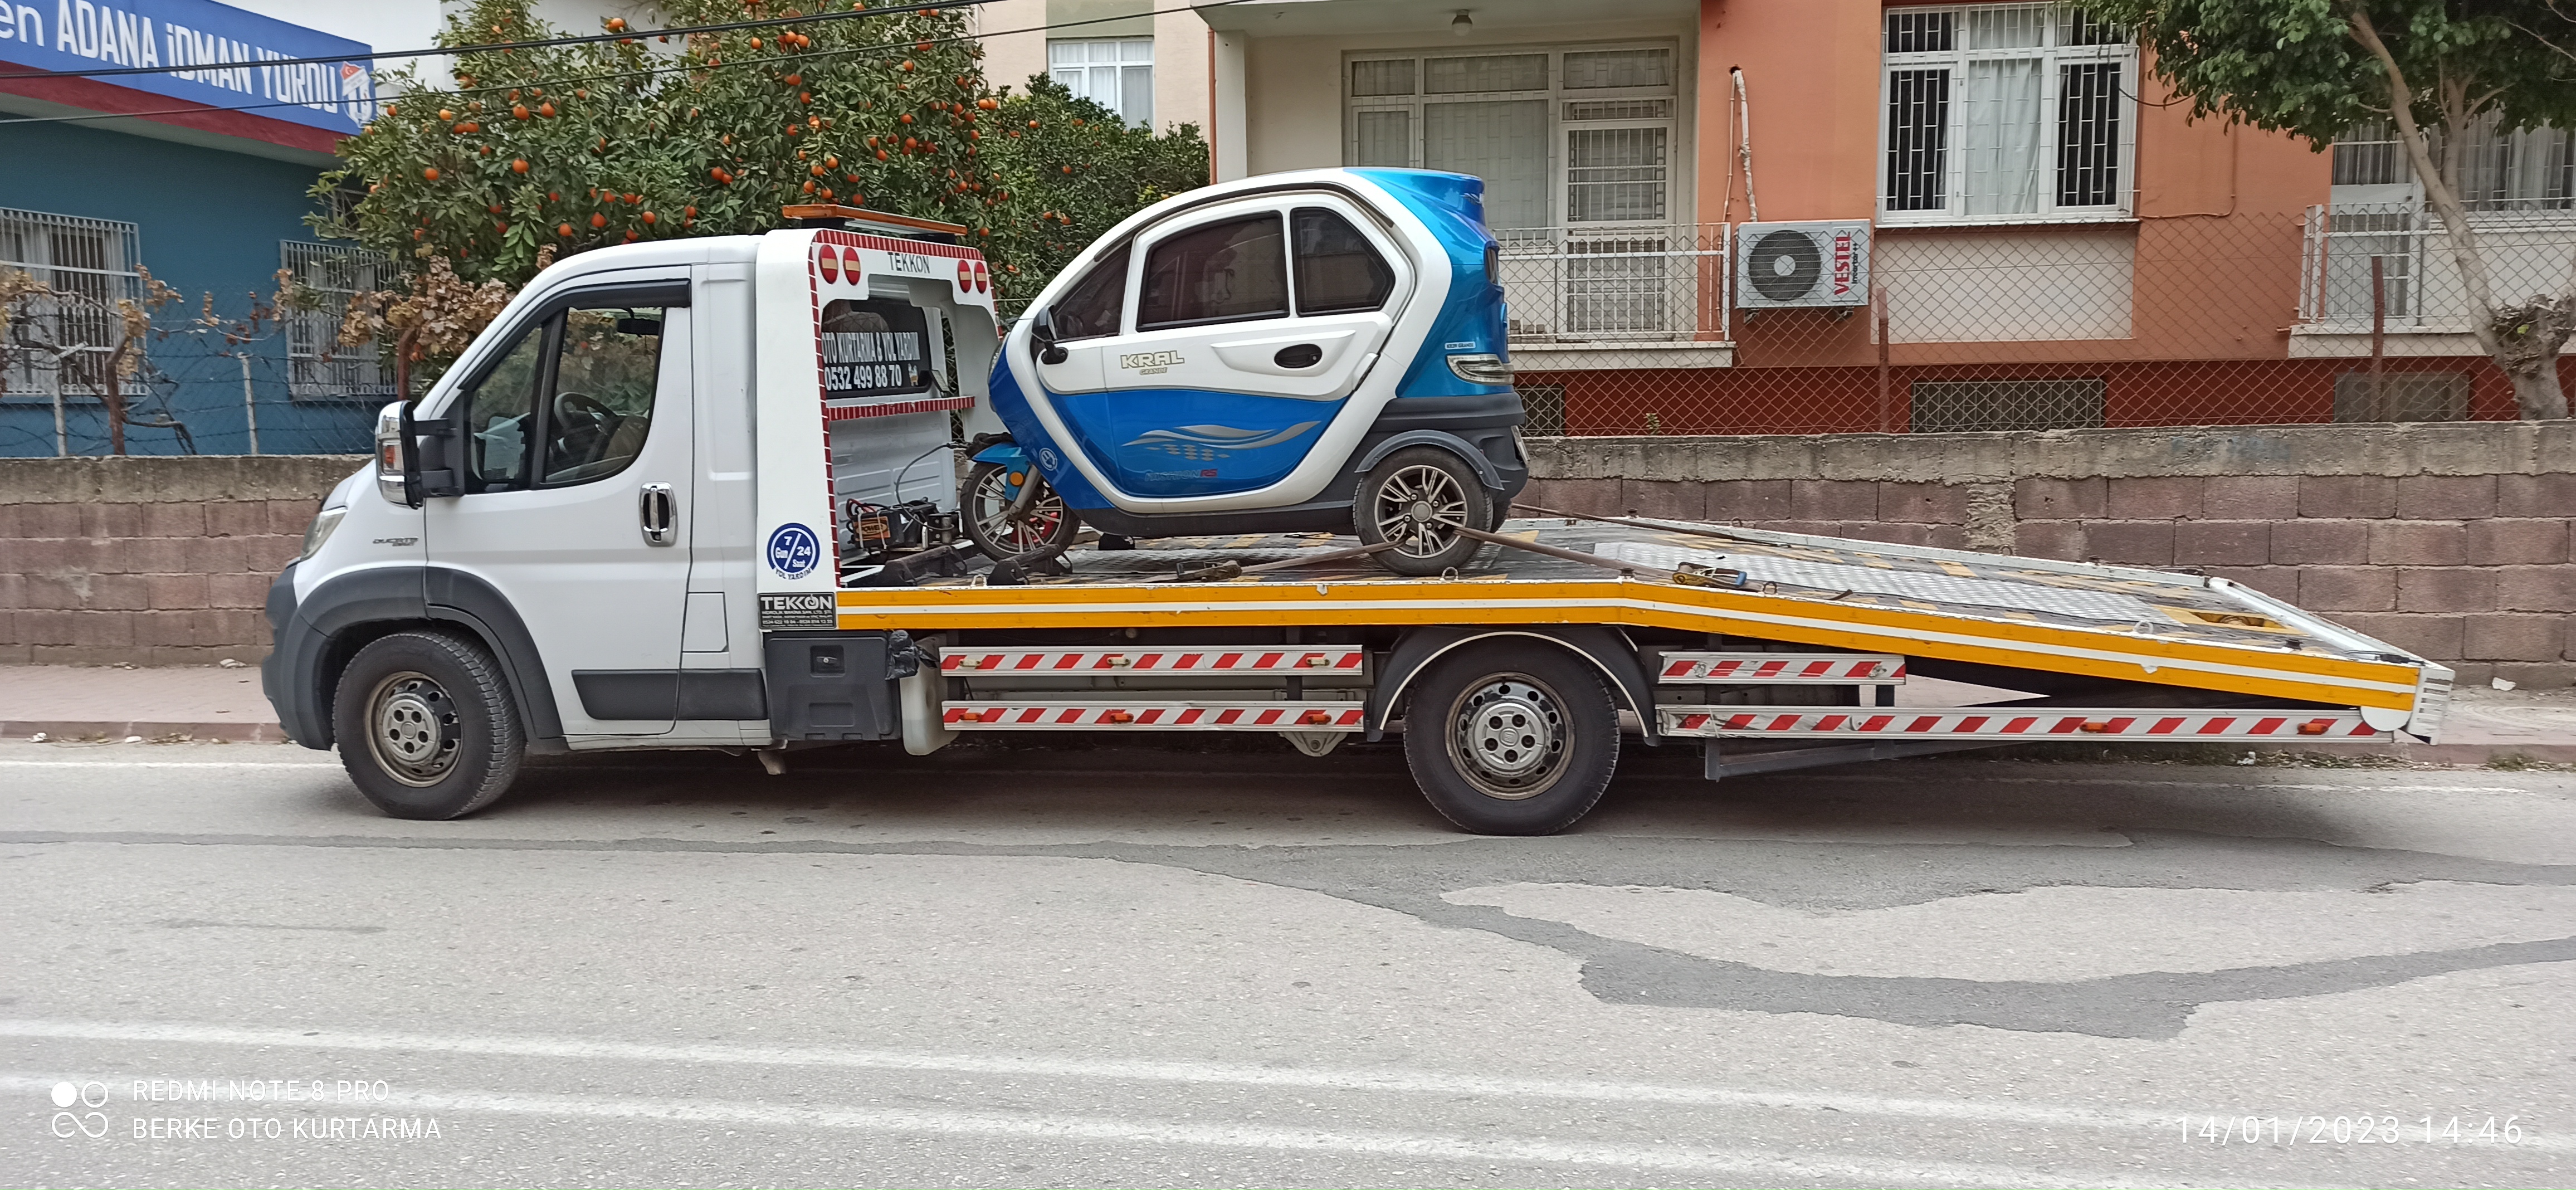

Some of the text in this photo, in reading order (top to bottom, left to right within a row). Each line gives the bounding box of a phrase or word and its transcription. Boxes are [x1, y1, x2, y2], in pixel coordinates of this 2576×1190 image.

[57, 0, 159, 69] ADANA
[256, 46, 338, 114] YURDU
[887, 252, 930, 274] TEKKON
[1834, 231, 1851, 295] VESTEL
[821, 332, 837, 363] OTO
[1120, 350, 1185, 369] KRAL
[824, 364, 902, 391] 0532 499 88 70
[1139, 367, 1168, 375] GRANDE
[784, 536, 793, 545] 7
[797, 546, 811, 556] 24
[760, 594, 833, 610] TEKKON
